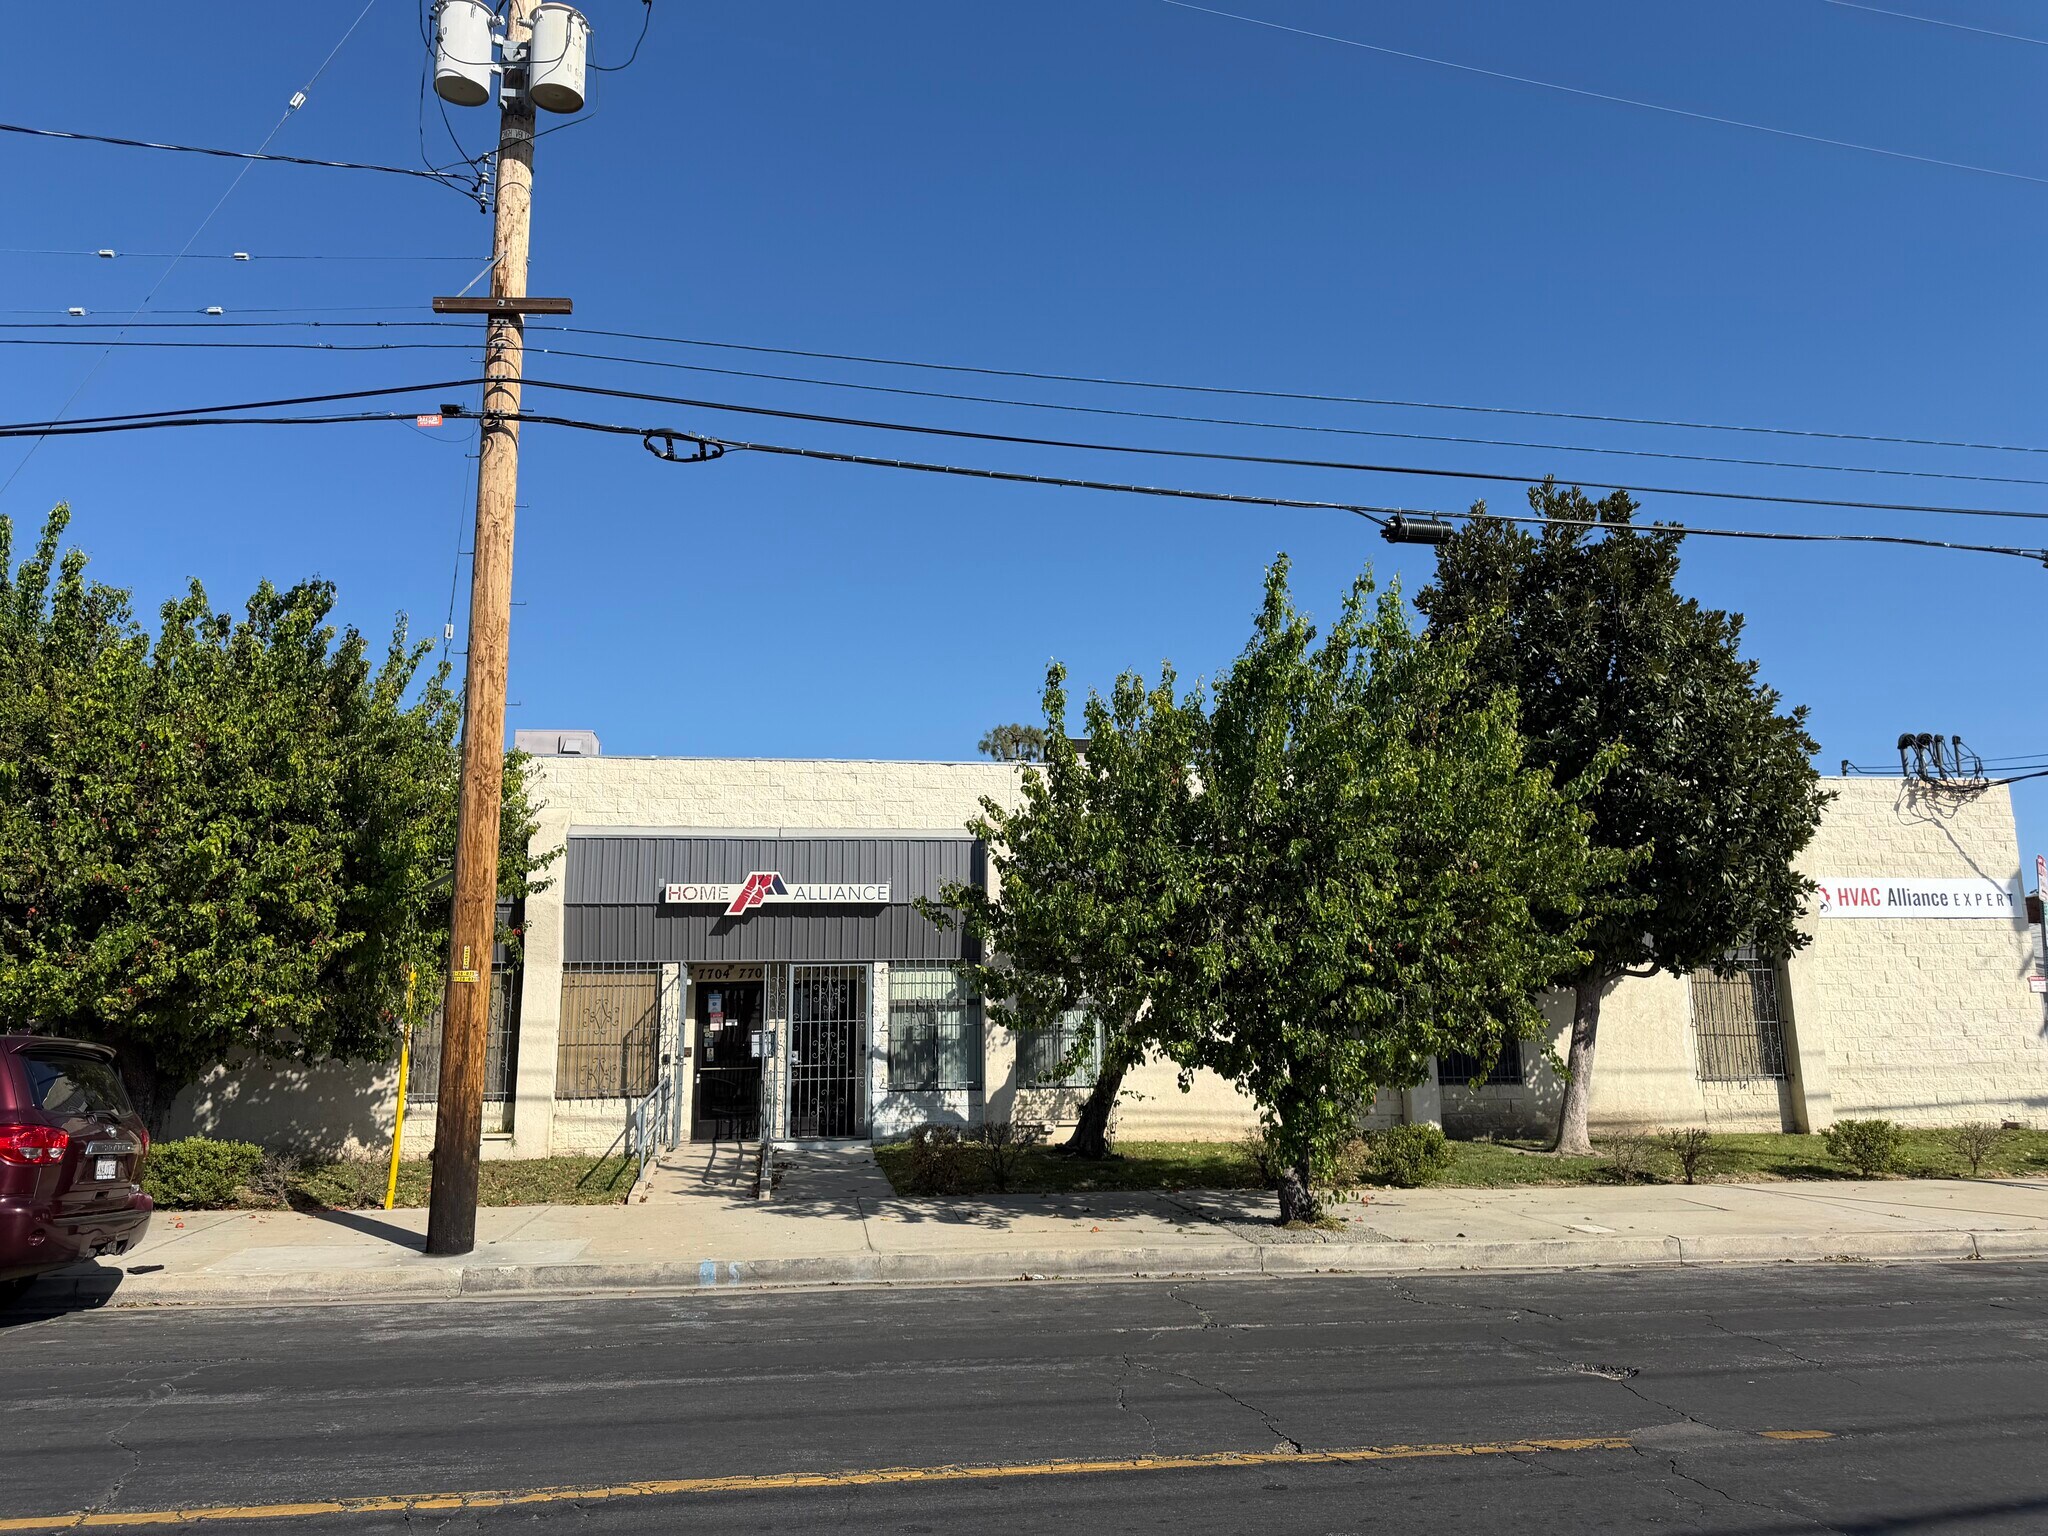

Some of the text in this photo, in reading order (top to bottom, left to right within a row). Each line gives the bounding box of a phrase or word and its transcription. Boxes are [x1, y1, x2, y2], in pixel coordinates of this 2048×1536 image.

[668, 886, 888, 901] HOME ALLIANCE
[1837, 887, 2014, 907] HVAC Alliance EXPERT
[698, 968, 730, 980] 7704
[739, 967, 764, 979] 770
